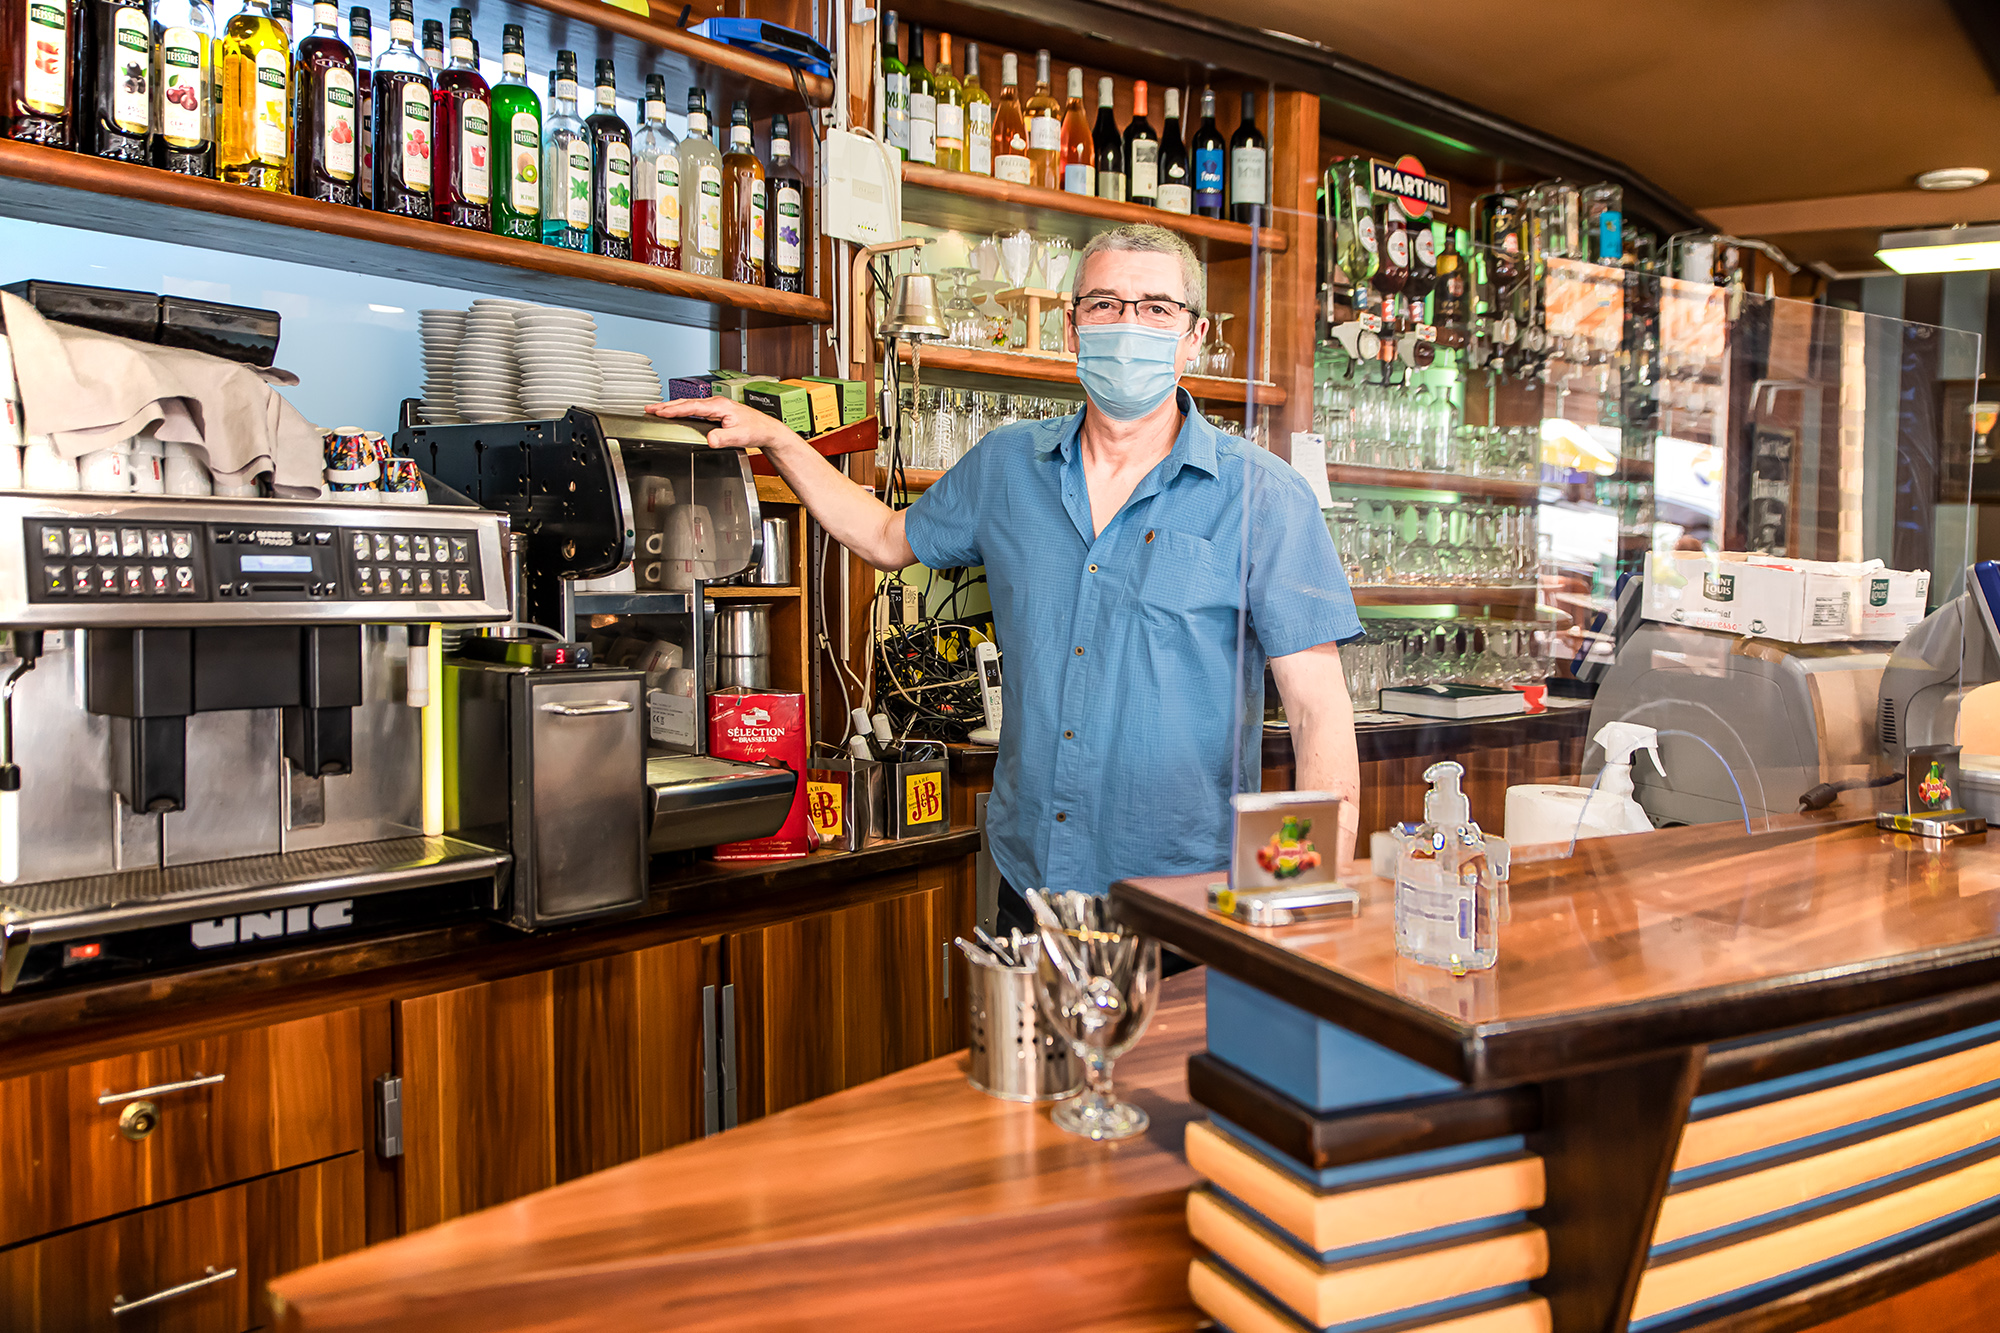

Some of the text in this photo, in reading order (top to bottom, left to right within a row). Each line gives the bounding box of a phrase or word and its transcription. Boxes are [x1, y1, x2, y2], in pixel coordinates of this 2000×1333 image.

[32, 8, 65, 25] TEISSEIRE
[167, 51, 199, 64] TEISSEIRE
[259, 71, 285, 86] TEISSEIRE
[329, 91, 353, 104] TEISSEIRE
[406, 105, 430, 118] TEISSEIRE
[1377, 167, 1446, 206] MARTINI
[1705, 584, 1732, 596] LOUIS
[1871, 581, 1888, 591] SAINT
[1871, 590, 1888, 601] LOUIS
[727, 726, 786, 737] SÉLECTION
[913, 776, 930, 785] RARE
[808, 785, 825, 793] ARE
[911, 780, 939, 822] J&B
[191, 899, 354, 950] UNIC
